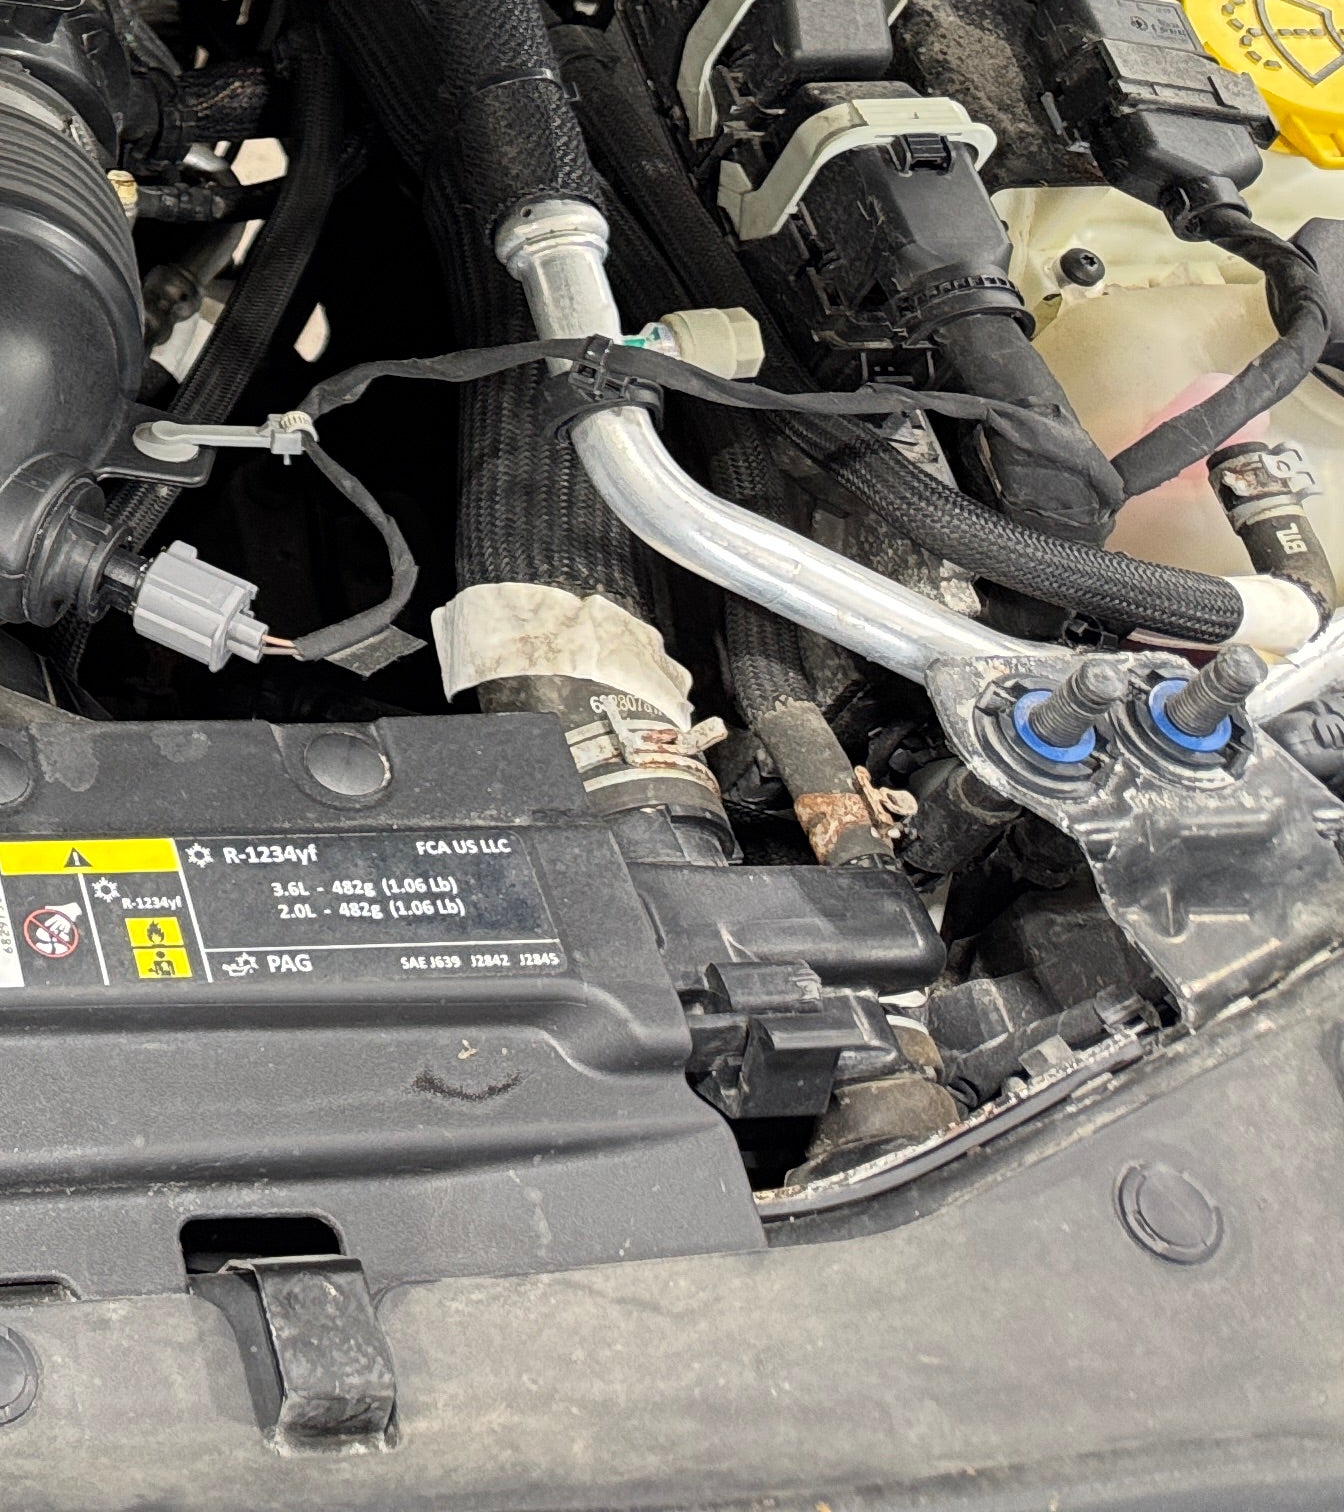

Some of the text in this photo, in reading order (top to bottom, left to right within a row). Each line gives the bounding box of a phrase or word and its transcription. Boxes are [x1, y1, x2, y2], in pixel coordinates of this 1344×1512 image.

[222, 843, 318, 866] R-1234yf
[415, 838, 512, 856] FCA US LLC
[270, 880, 311, 898] 3.6L
[331, 879, 377, 899] 482g
[381, 877, 429, 897] (1.06
[430, 875, 459, 896] Lb)
[121, 896, 183, 911] R-1234yf
[277, 903, 318, 920] 2.0L
[338, 900, 384, 920] 482g
[388, 899, 436, 920] (1.06
[438, 898, 467, 918] Lb)
[266, 953, 313, 975] PAG
[400, 951, 561, 970] SAE J639 J2842 J2845
